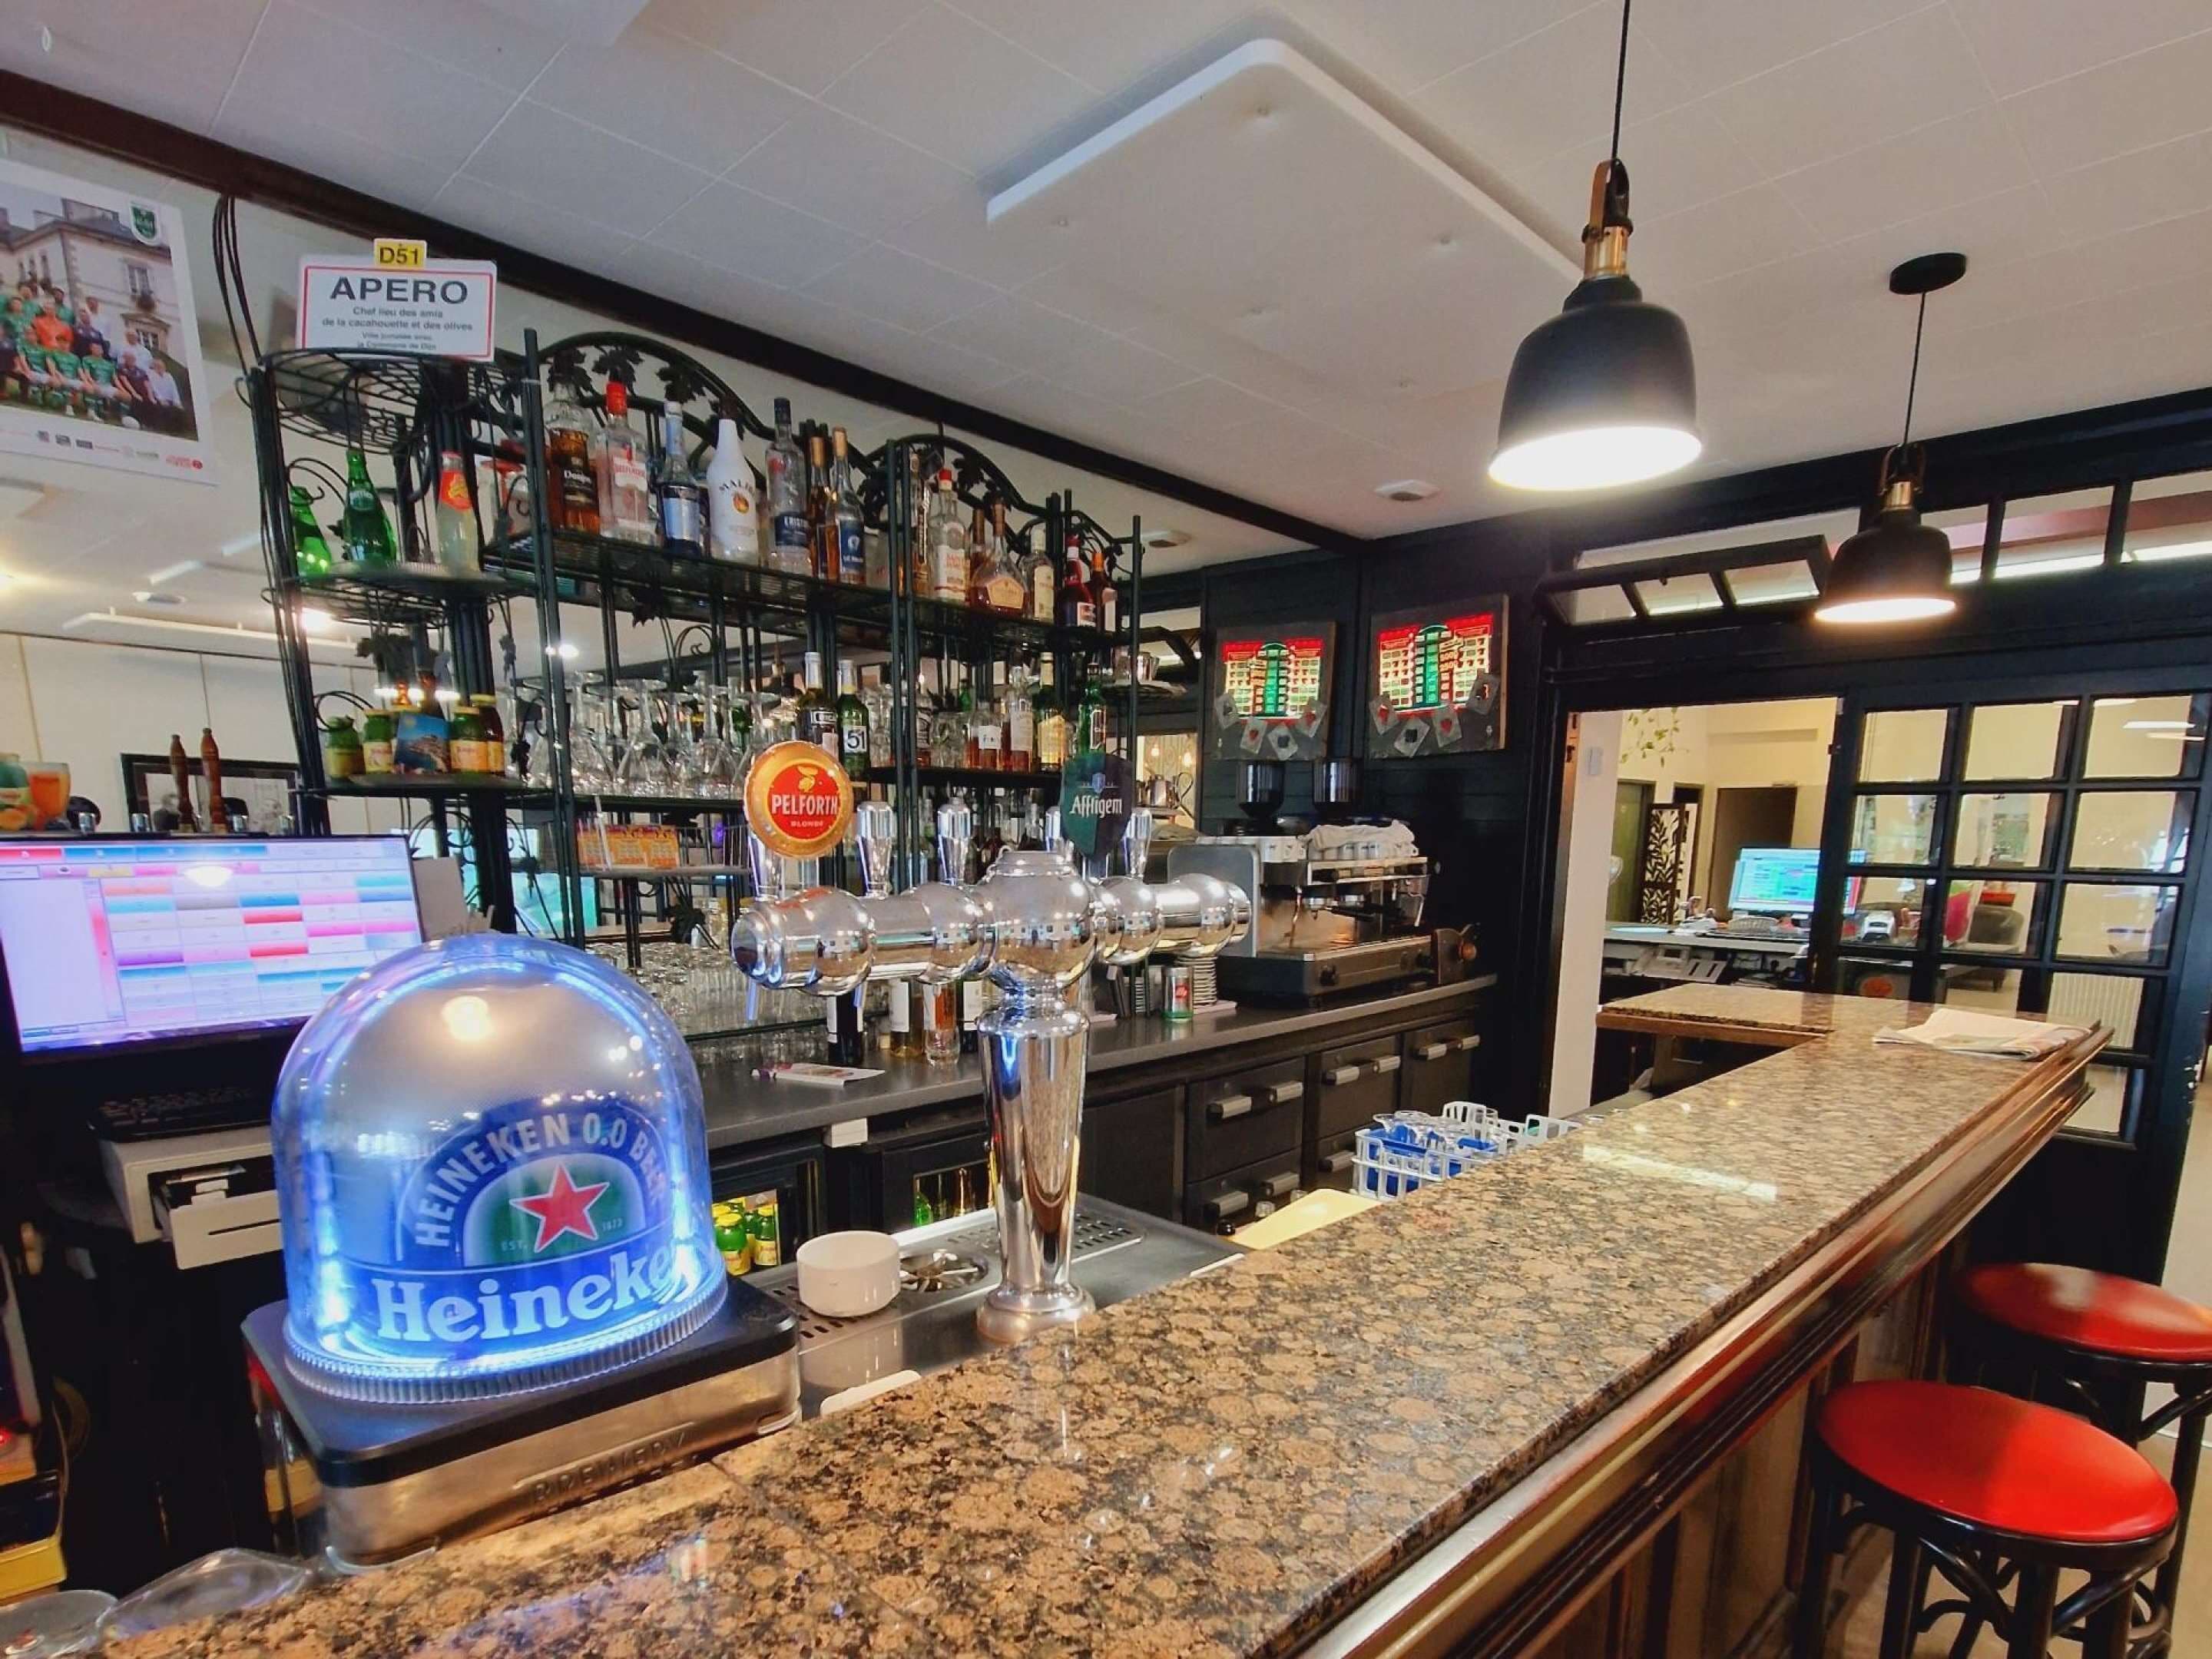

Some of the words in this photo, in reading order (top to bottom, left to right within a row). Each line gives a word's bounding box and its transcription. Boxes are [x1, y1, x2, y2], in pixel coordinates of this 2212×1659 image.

[379, 247, 419, 265] D51
[329, 276, 469, 305] APERO
[399, 308, 417, 317] des
[322, 318, 335, 326] de
[423, 320, 441, 329] des
[443, 320, 473, 331] olives
[846, 730, 866, 750] 51
[770, 794, 839, 816] PELFORTH
[1069, 795, 1123, 819] Affligem
[415, 1111, 571, 1247] HEINEKEN
[583, 1112, 628, 1147] 0.0
[370, 1246, 697, 1343] Heineke
